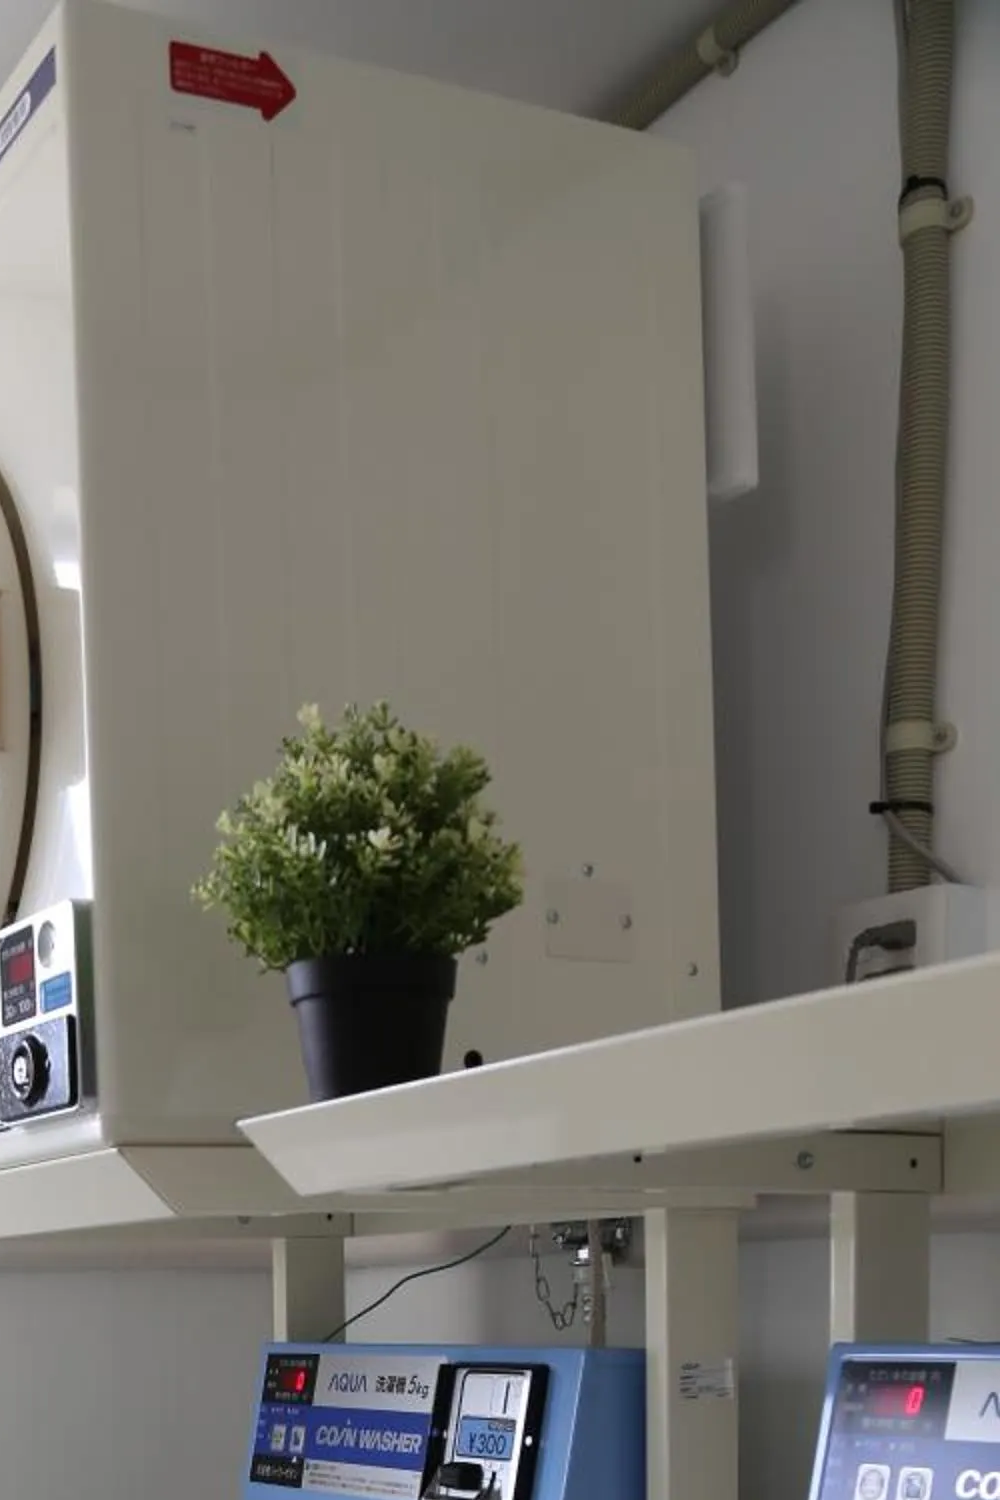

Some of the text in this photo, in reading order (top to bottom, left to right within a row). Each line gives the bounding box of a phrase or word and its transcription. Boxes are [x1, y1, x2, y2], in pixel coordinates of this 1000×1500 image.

[327, 1372, 367, 1393] AQUA
[407, 1374, 430, 1399] 5kg
[904, 1385, 925, 1416] 0
[358, 1428, 422, 1455] WASHER
[469, 1431, 507, 1456] ¥300
